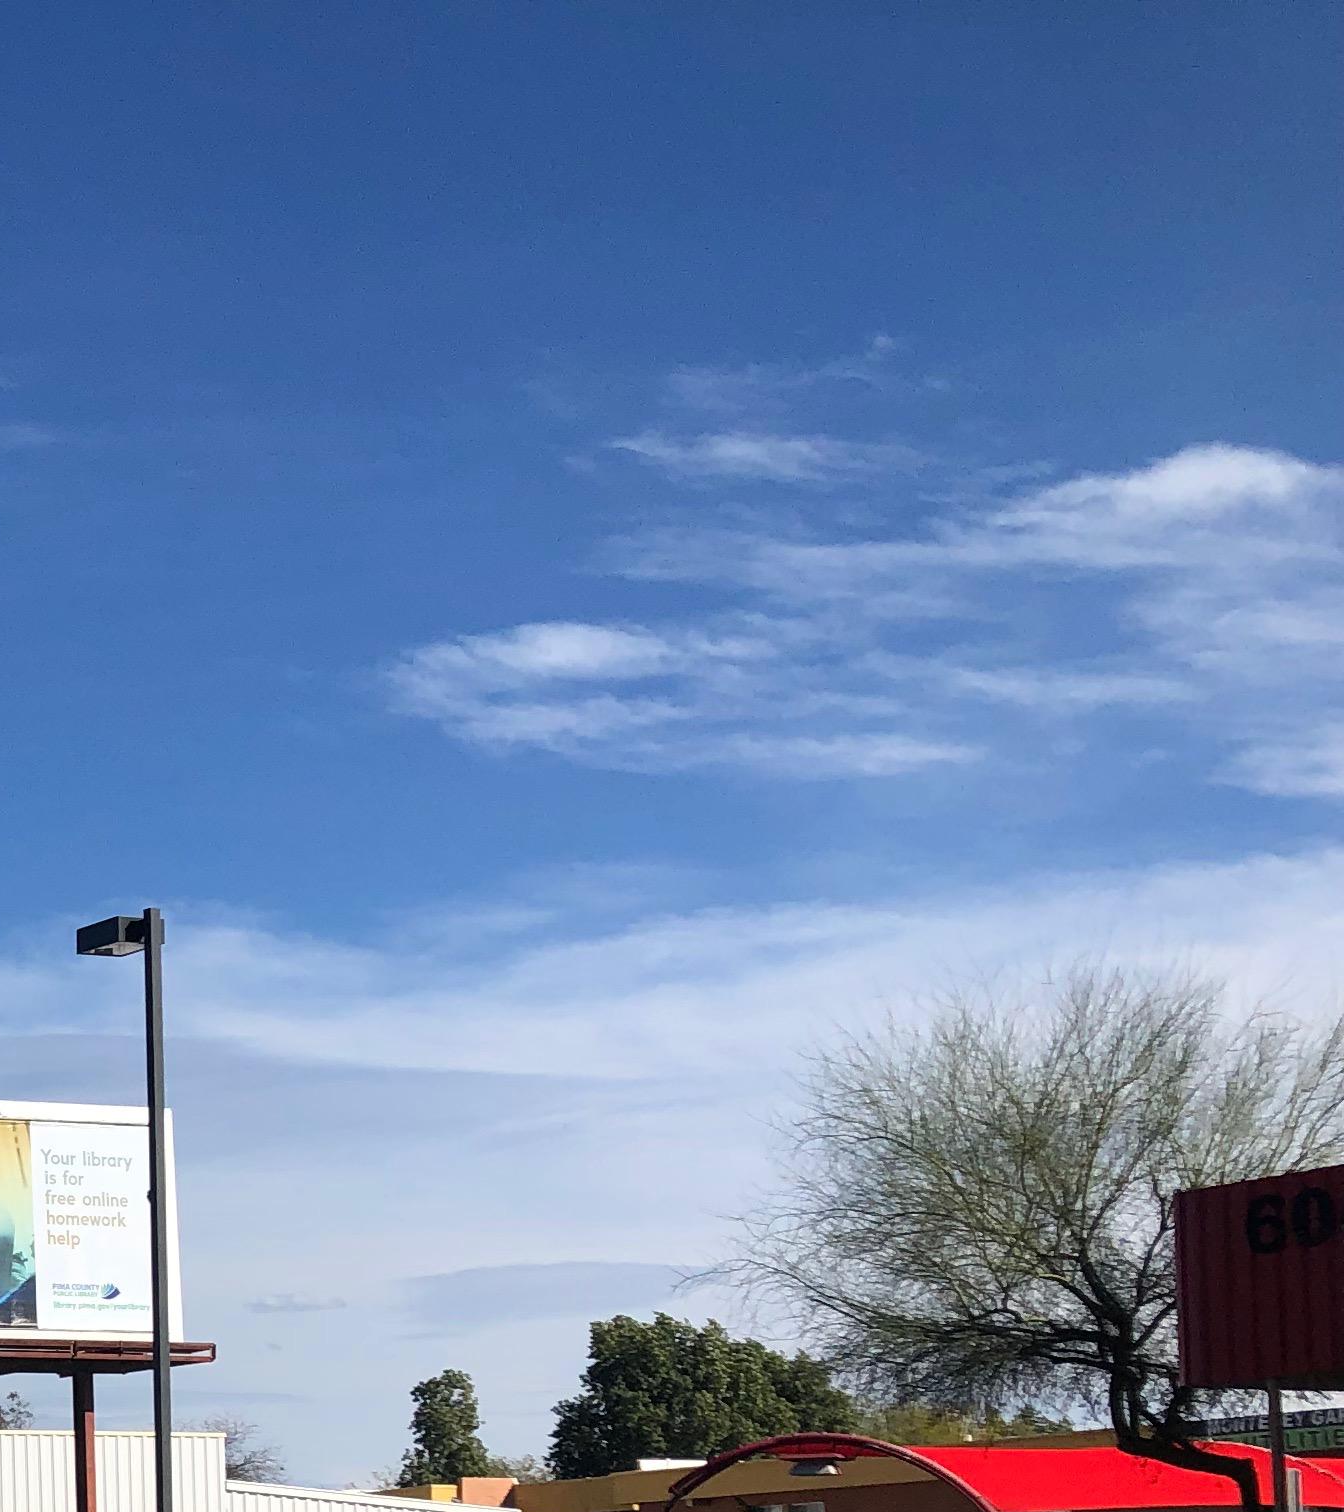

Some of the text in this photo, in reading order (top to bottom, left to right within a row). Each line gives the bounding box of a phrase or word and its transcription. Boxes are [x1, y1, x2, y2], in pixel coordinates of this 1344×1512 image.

[40, 1148, 133, 1172] Your library
[44, 1170, 84, 1185] is for
[45, 1189, 128, 1207] free online
[46, 1210, 127, 1227] homework
[47, 1229, 81, 1249] help
